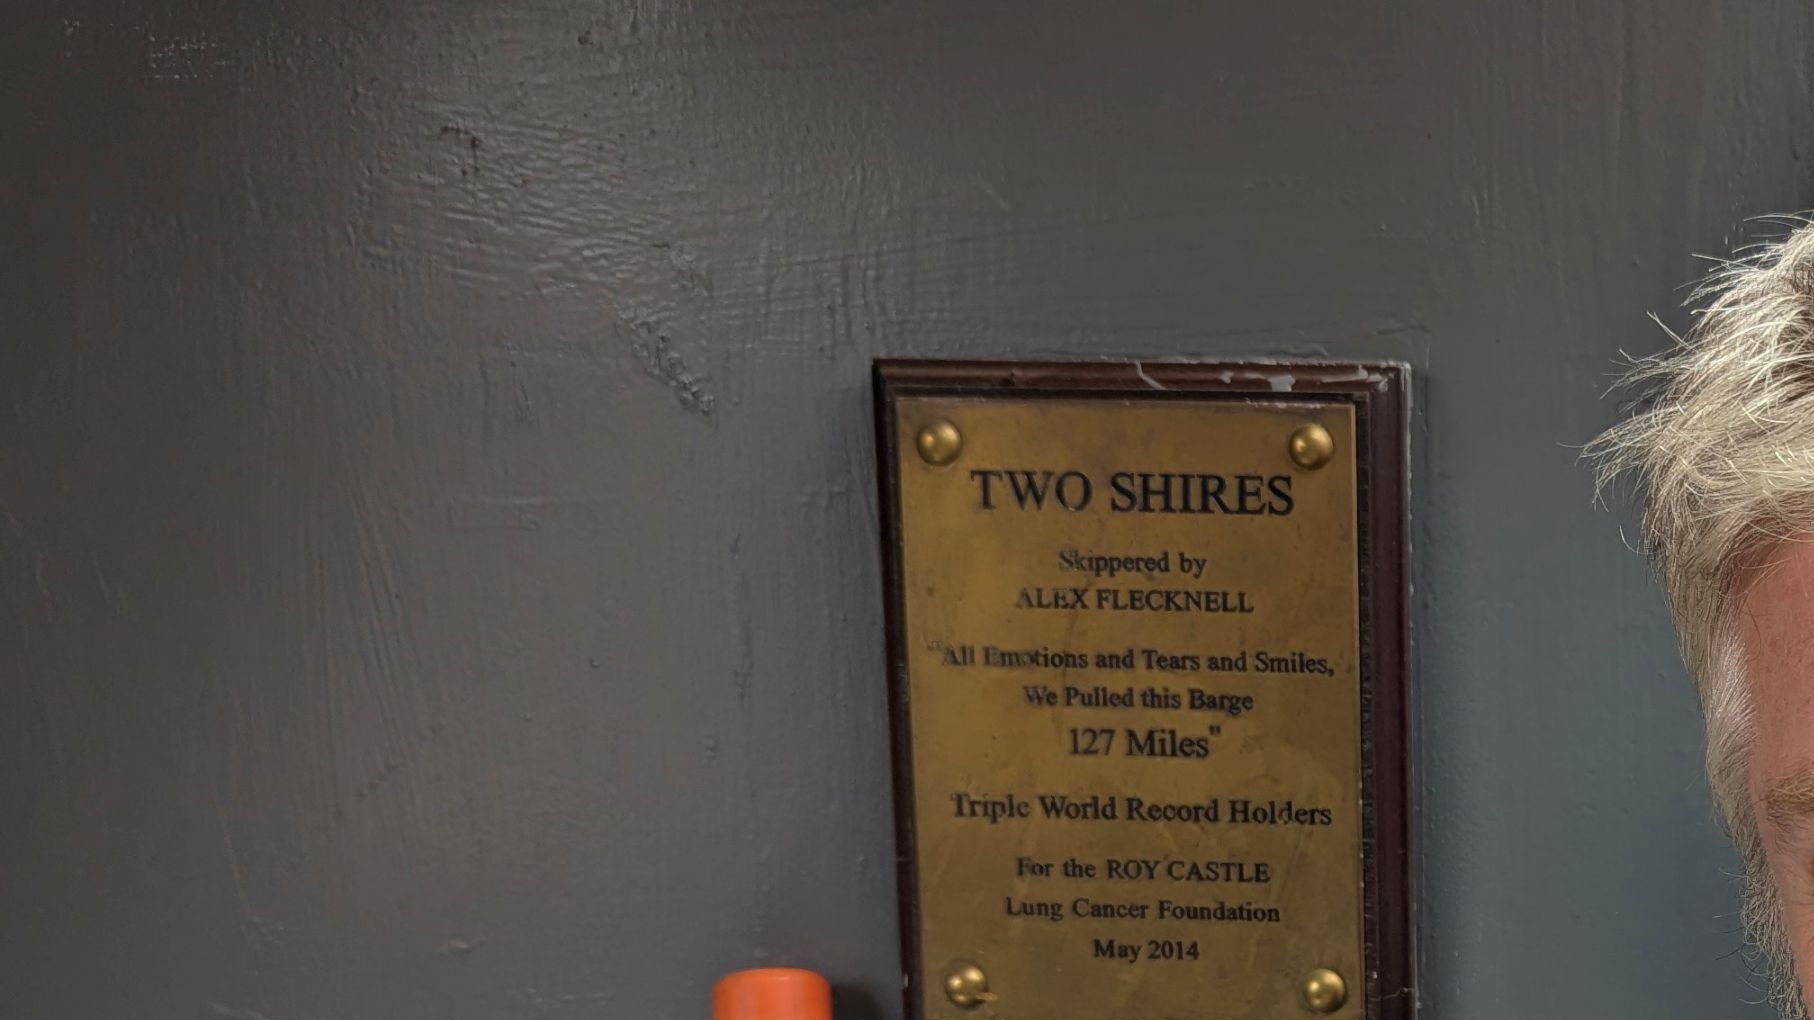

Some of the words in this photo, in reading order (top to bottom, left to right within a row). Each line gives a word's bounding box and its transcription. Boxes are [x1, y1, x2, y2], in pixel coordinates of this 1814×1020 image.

[970, 469, 1093, 512] TWO
[1110, 472, 1295, 516] SHIRES
[1058, 549, 1169, 577] Skippered
[1179, 552, 1207, 578] by
[1015, 587, 1089, 610] ALEX
[1096, 589, 1254, 613] FLECKNELL
[983, 646, 1088, 669] Emotions
[1095, 648, 1134, 669] and
[1142, 650, 1200, 671] Tears
[1207, 651, 1247, 672] and
[1255, 652, 1334, 676] Smiles,
[1023, 685, 1057, 707] We
[1066, 686, 1134, 708] Pulled
[1140, 689, 1181, 709] this
[1189, 690, 1254, 716] Barge
[1069, 729, 1115, 756] 127
[1125, 725, 1221, 758] Miles"
[951, 793, 1029, 825] Triple
[1039, 795, 1118, 820] World
[1126, 798, 1219, 823] Record
[1228, 801, 1332, 826] Holders
[1017, 857, 1054, 877] For
[1063, 860, 1096, 878] the
[1107, 860, 1160, 880] ROY
[1167, 860, 1270, 883] CASTLE
[1005, 898, 1064, 921] Lung
[1072, 899, 1149, 919] Cancer
[1159, 901, 1280, 922] Foundation
[1094, 940, 1141, 963] May
[1148, 940, 1199, 961] 2014
